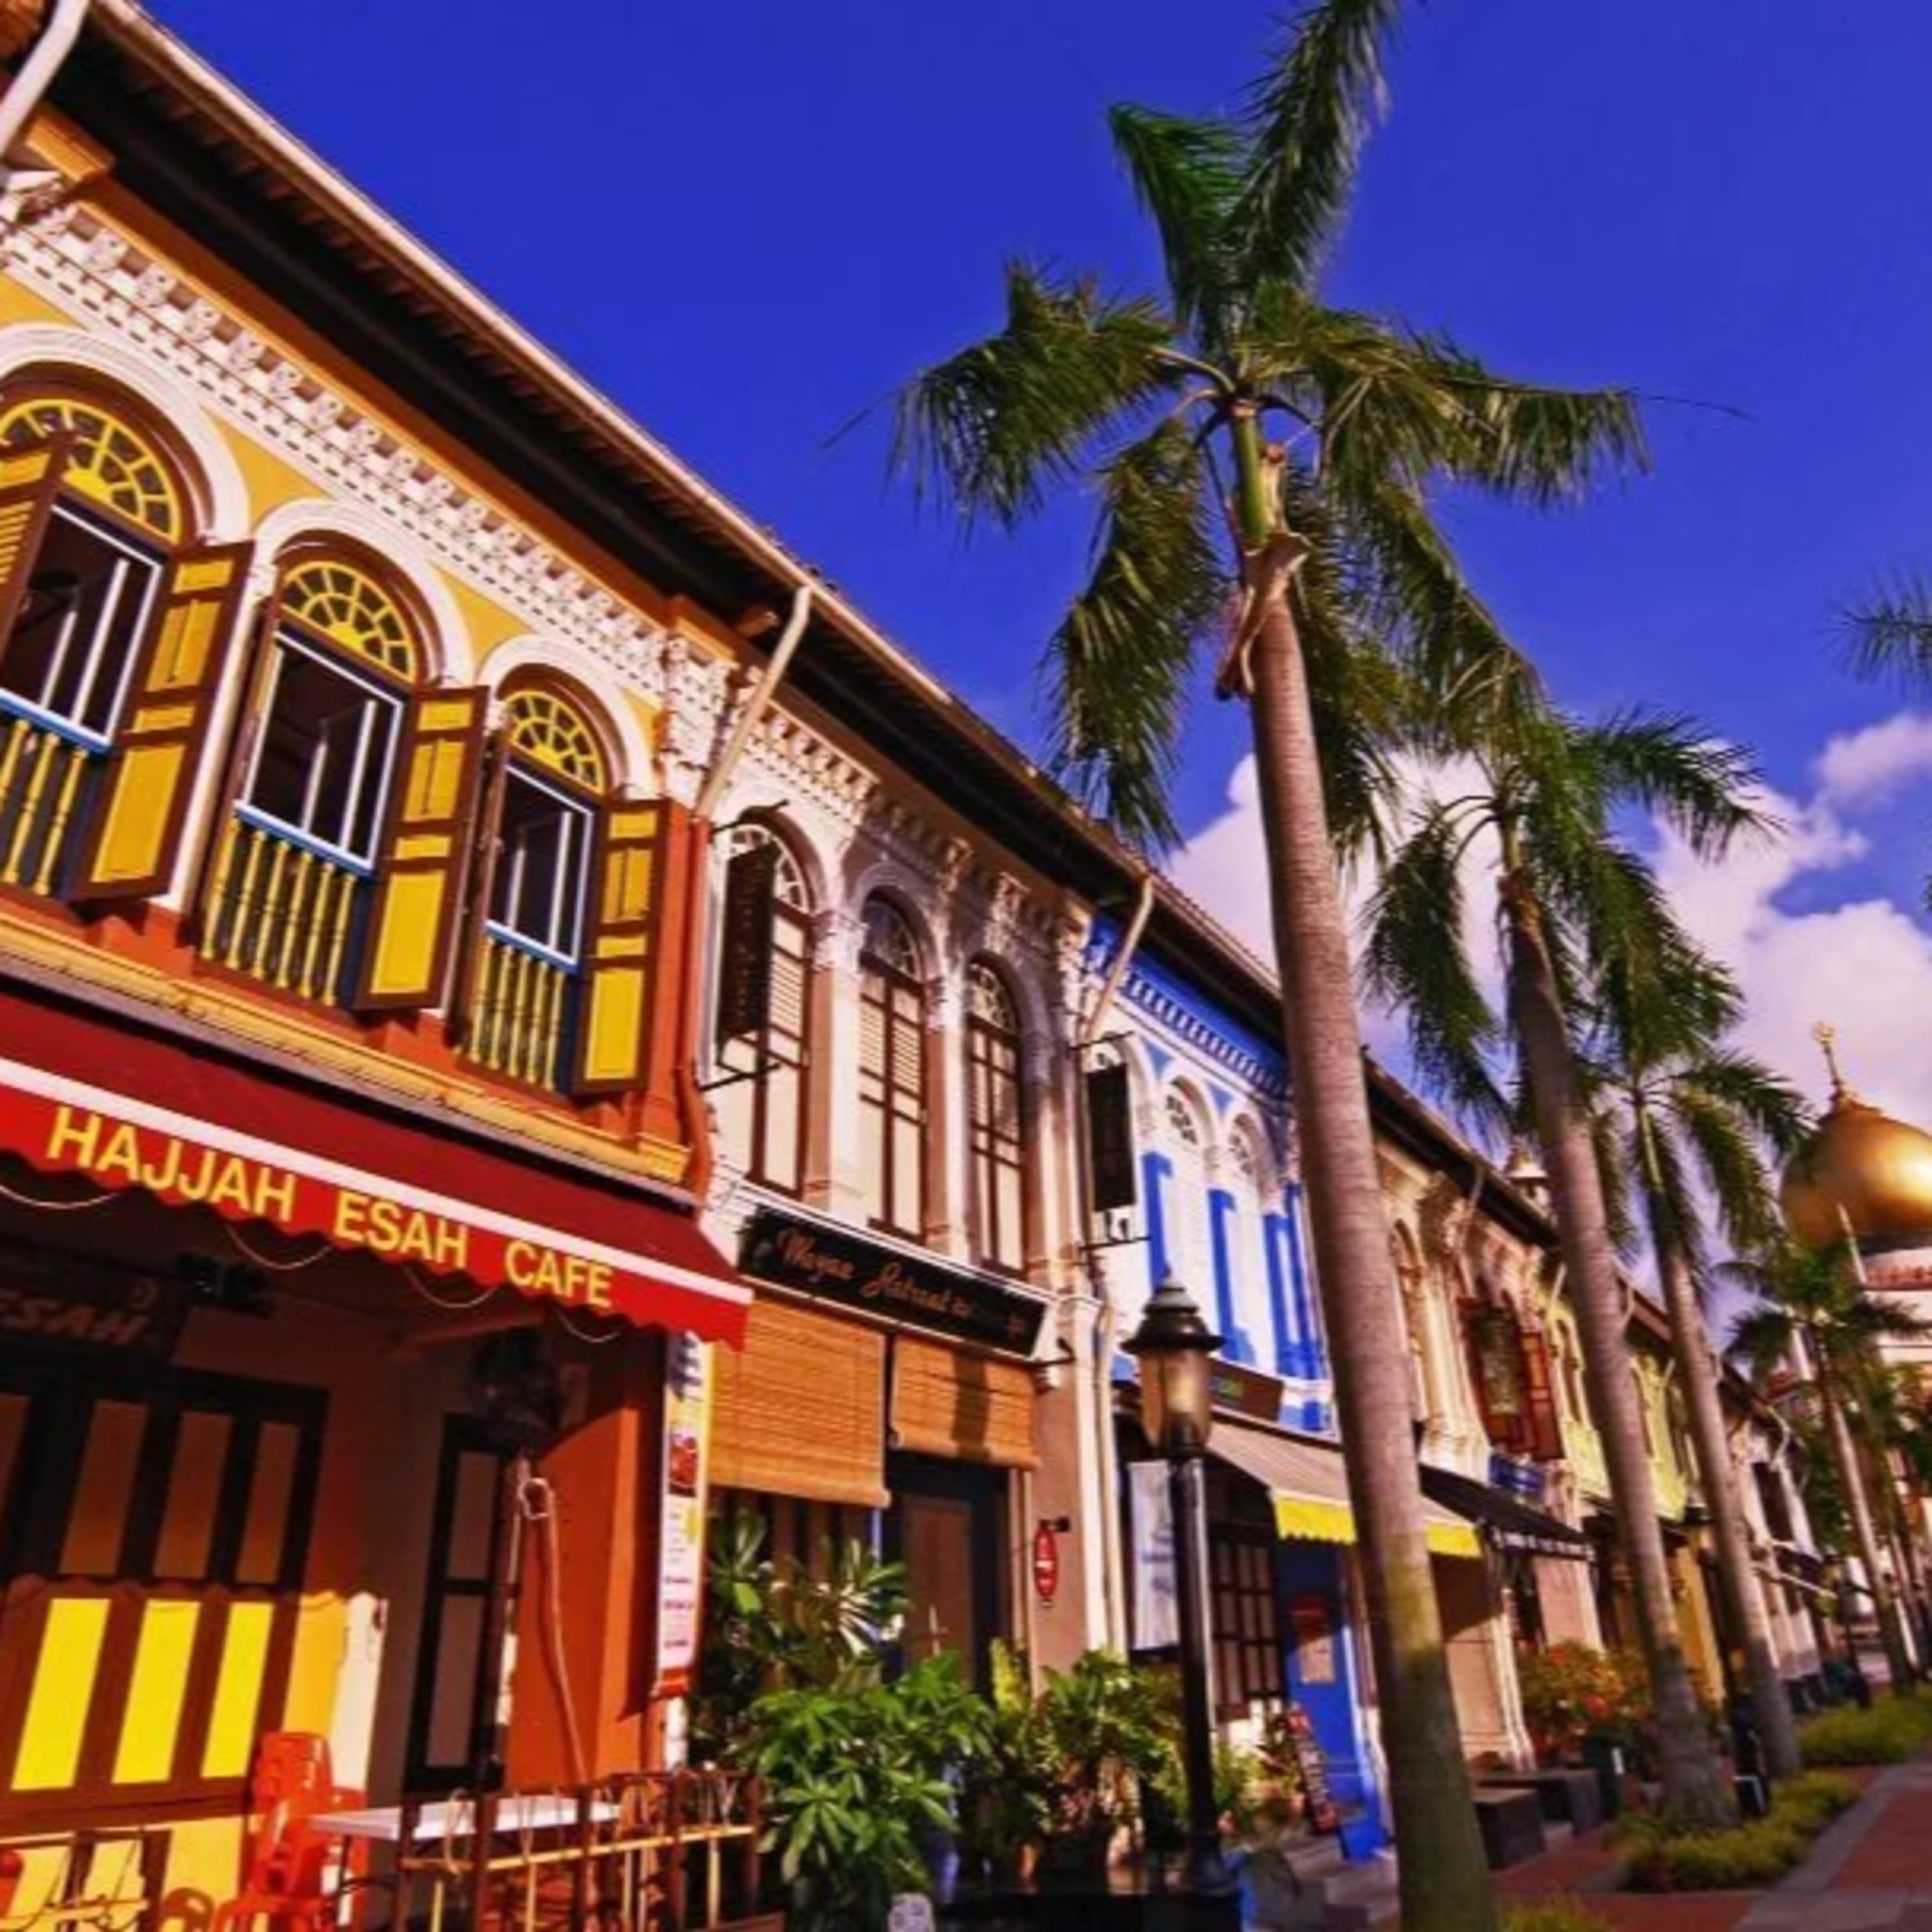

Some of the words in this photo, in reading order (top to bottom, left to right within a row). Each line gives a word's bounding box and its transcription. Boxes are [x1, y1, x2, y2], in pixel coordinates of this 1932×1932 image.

[47, 1106, 296, 1222] HAJJAH
[334, 1191, 468, 1270] ESAH
[504, 1240, 613, 1307] CAFE
